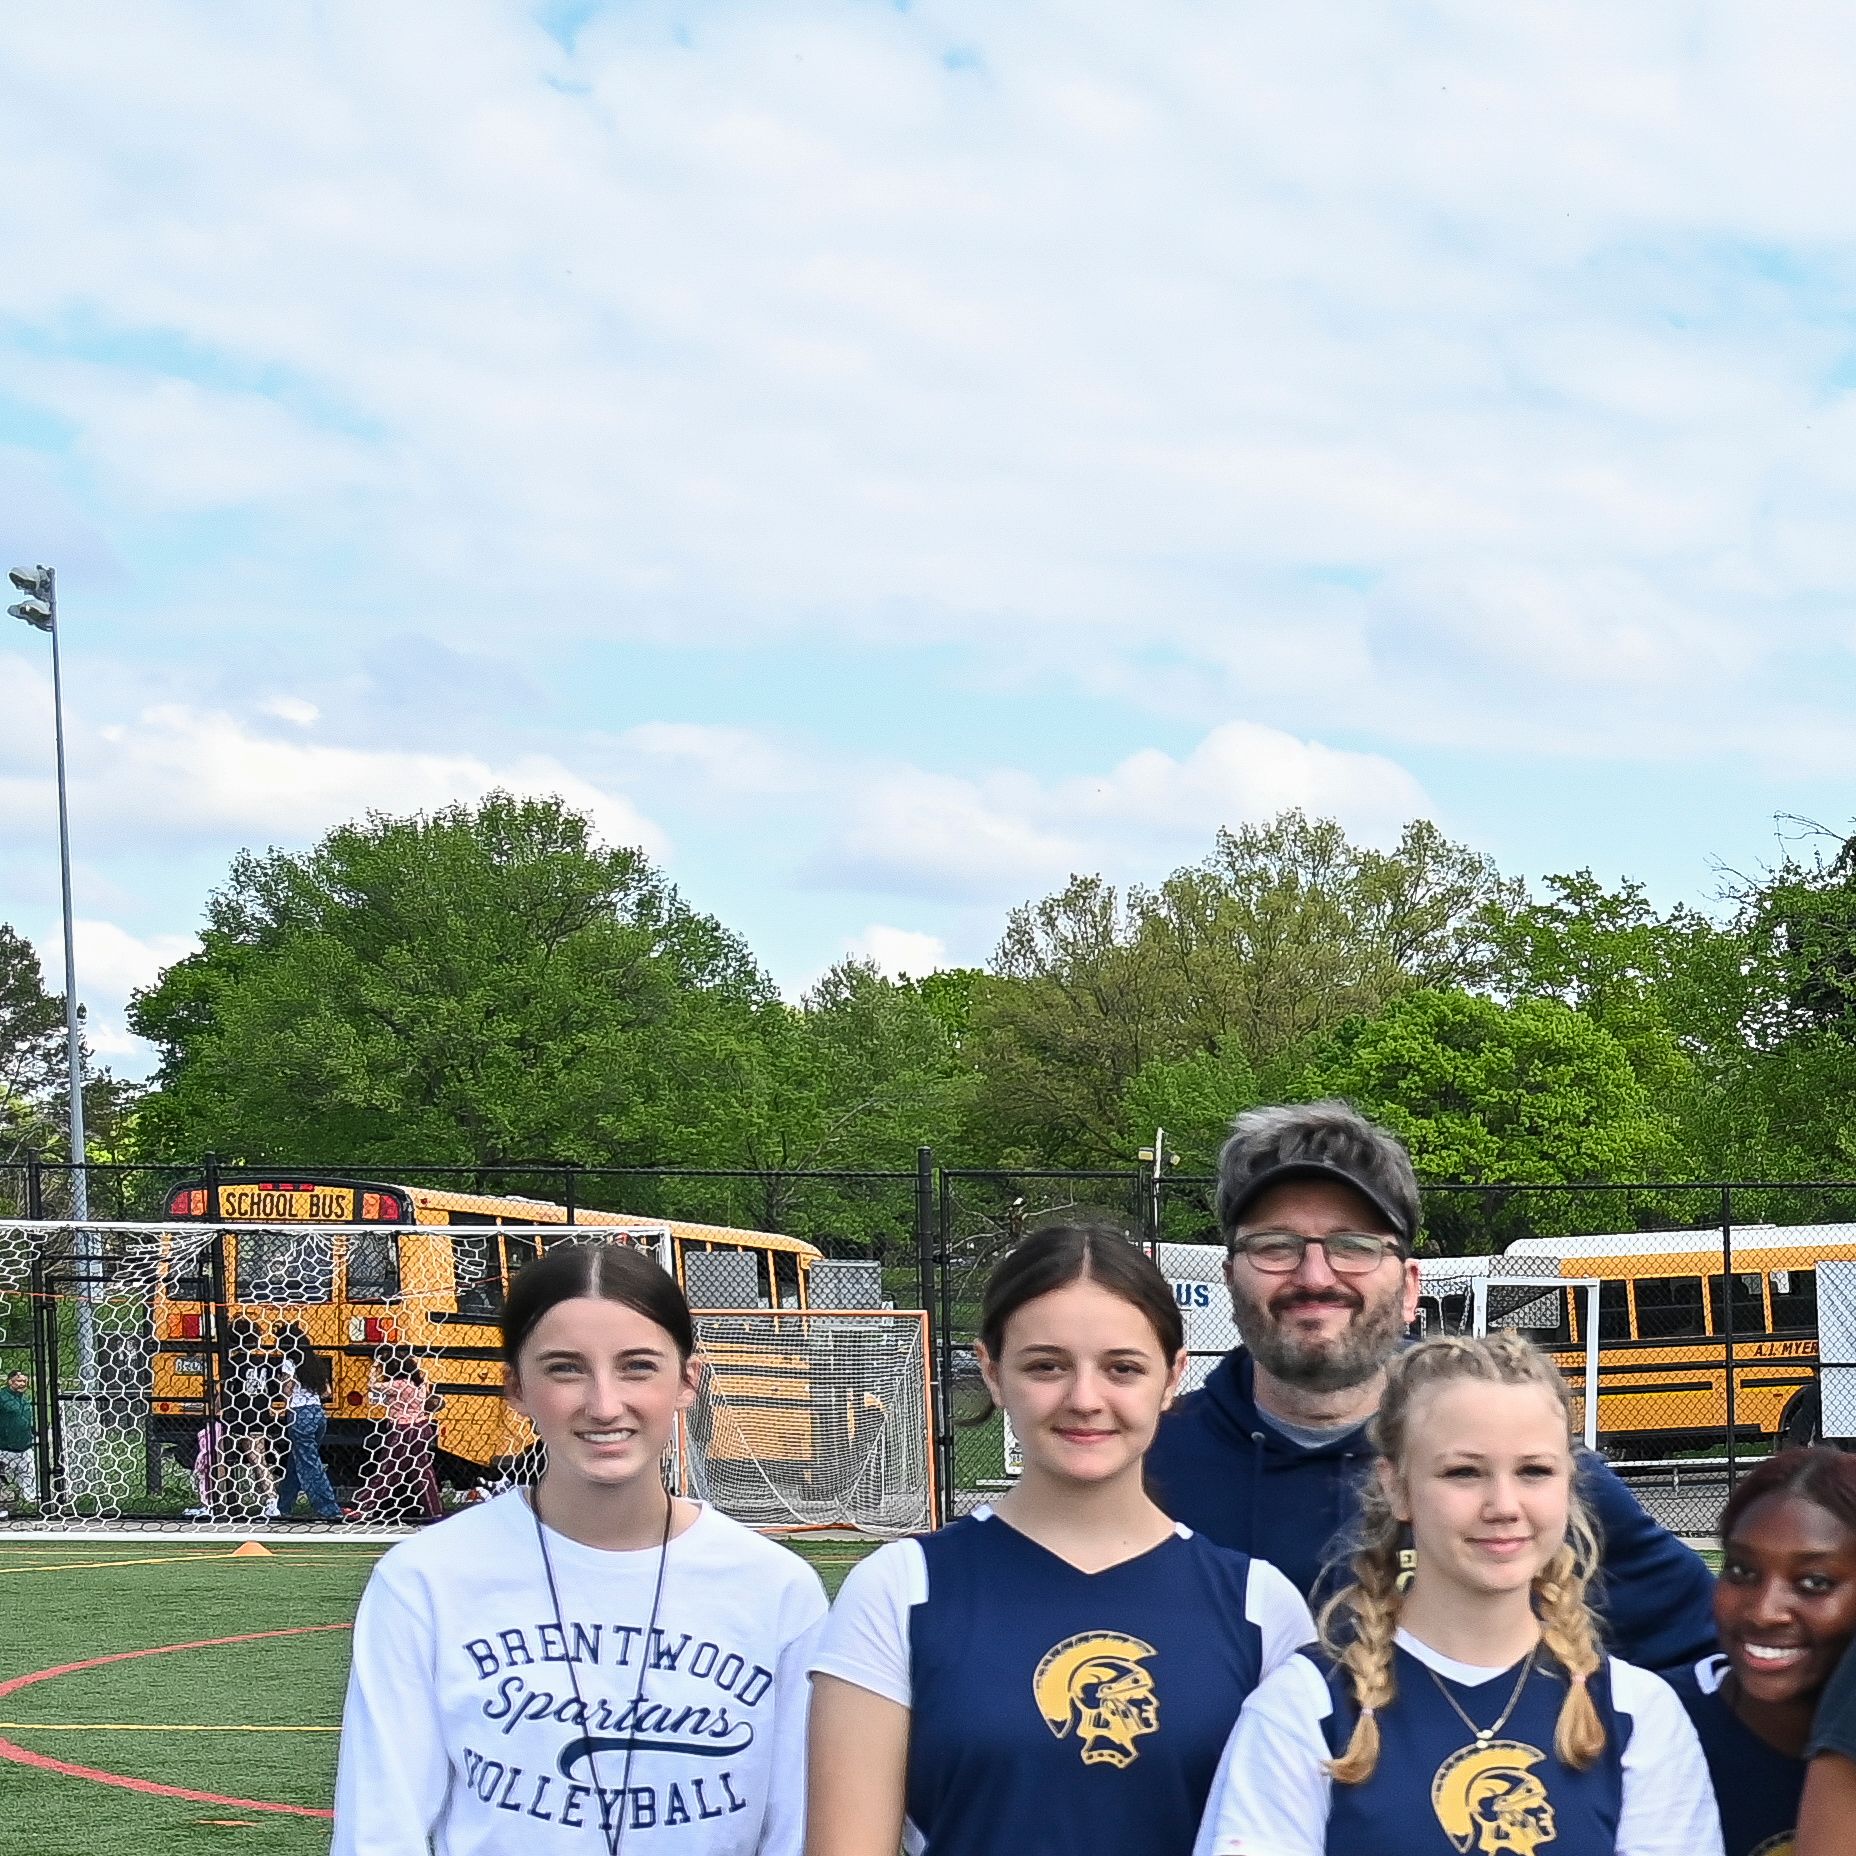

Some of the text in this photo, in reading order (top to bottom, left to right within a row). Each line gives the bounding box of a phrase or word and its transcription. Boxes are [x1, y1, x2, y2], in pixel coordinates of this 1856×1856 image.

[225, 1191, 347, 1219] SCHOOL BUS
[1175, 1283, 1210, 1308] US
[1781, 1341, 1819, 1356] MYER
[463, 1621, 774, 1707] BRENTWOOD
[482, 1676, 755, 1739] Spartans
[463, 1746, 747, 1831] VOLLEYBALL
